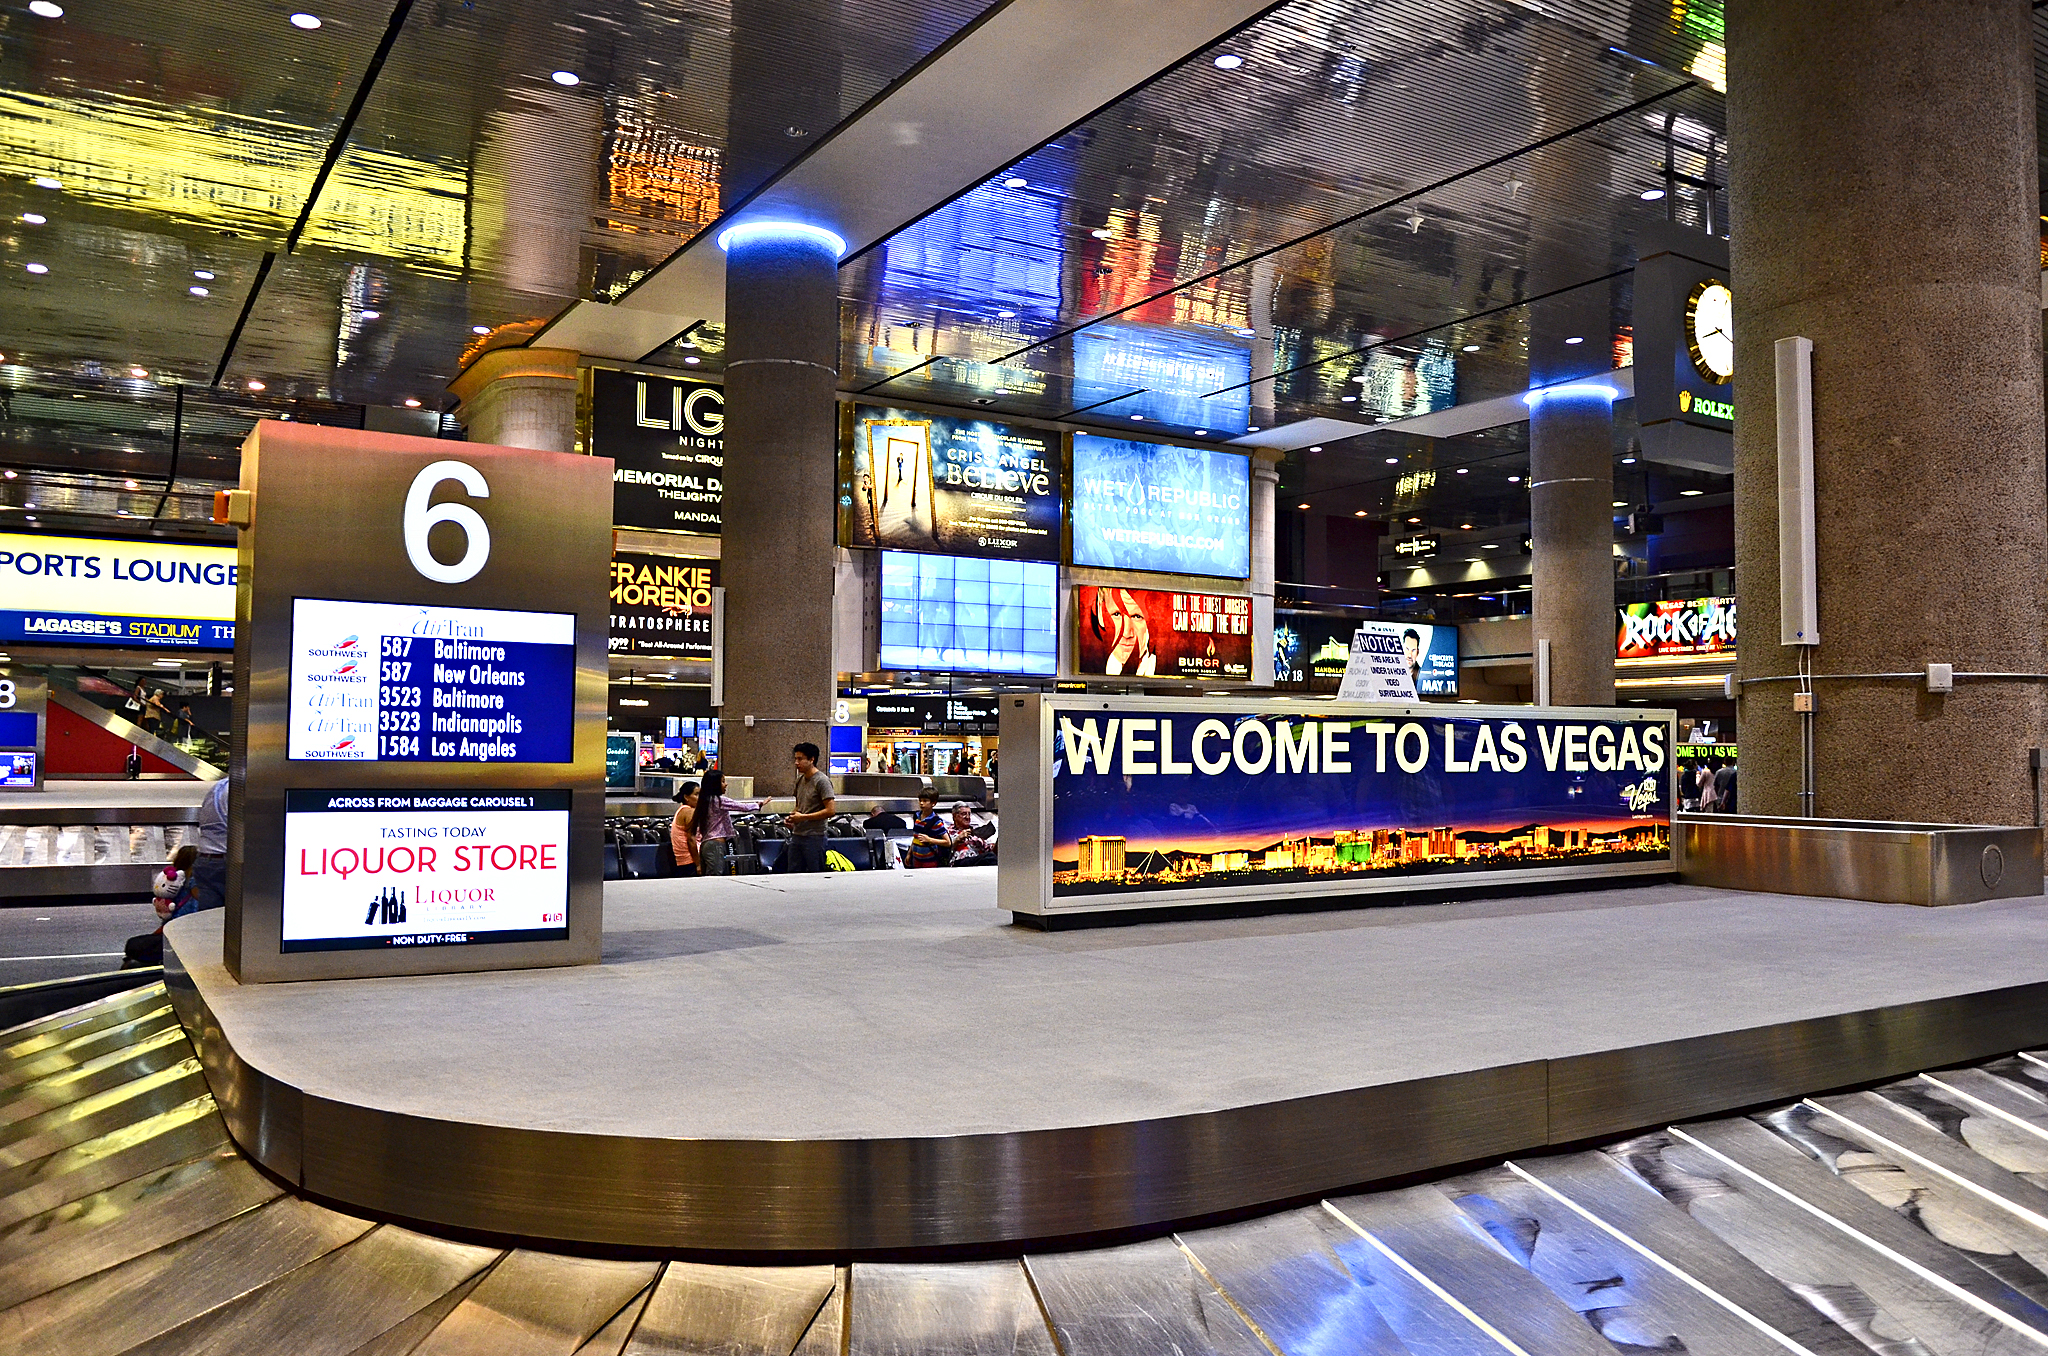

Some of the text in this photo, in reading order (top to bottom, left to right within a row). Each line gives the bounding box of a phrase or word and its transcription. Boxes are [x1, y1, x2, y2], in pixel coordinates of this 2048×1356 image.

[637, 381, 725, 436] LIG
[1693, 397, 1735, 420] ROLEX
[947, 448, 1050, 472] CRISS ANGEL
[1083, 478, 1241, 510] WET REPUBLIC
[404, 460, 490, 584] 6
[987, 538, 1018, 547] LUXOR
[1102, 527, 1225, 551] WETREPUBLIC.COM
[113, 558, 238, 586] LOUNGE
[1687, 599, 1708, 608] BEST
[1710, 597, 1736, 606] PARTY
[24, 618, 122, 635] LAGASSE'S
[129, 622, 199, 638] STADIUM
[1173, 611, 1248, 635] CAN STAND THE HEAT
[1619, 608, 1694, 651] ROCK
[308, 649, 368, 658] SOUTHWEST
[381, 637, 506, 661] 587 Baltimore
[1359, 634, 1403, 653] NOTICE
[1179, 657, 1220, 667] BURGR
[1370, 655, 1382, 663] THIS
[1382, 656, 1395, 664] AREA
[307, 674, 368, 683] SOUTHWEST
[381, 661, 525, 686] 587 New Orleans
[1292, 670, 1303, 682] 18
[380, 685, 504, 709] 3523 Baltimore
[1422, 680, 1456, 693] MAY 11
[834, 700, 850, 723] 8
[379, 711, 522, 737] 3523 Indianapolis
[1702, 720, 1711, 736] 7
[380, 735, 517, 761] 1584 Los Angeles
[1060, 716, 1665, 775] WELCOME TO LAS VEGAS
[1695, 746, 1708, 758] TO
[328, 797, 534, 808] ACROSS FROM BAGGAGE CAROUSEL 1
[380, 826, 487, 838] TASTING TODAY
[301, 844, 557, 880] LIQUOR STORE
[393, 934, 467, 945] NON DUTY-FREE
